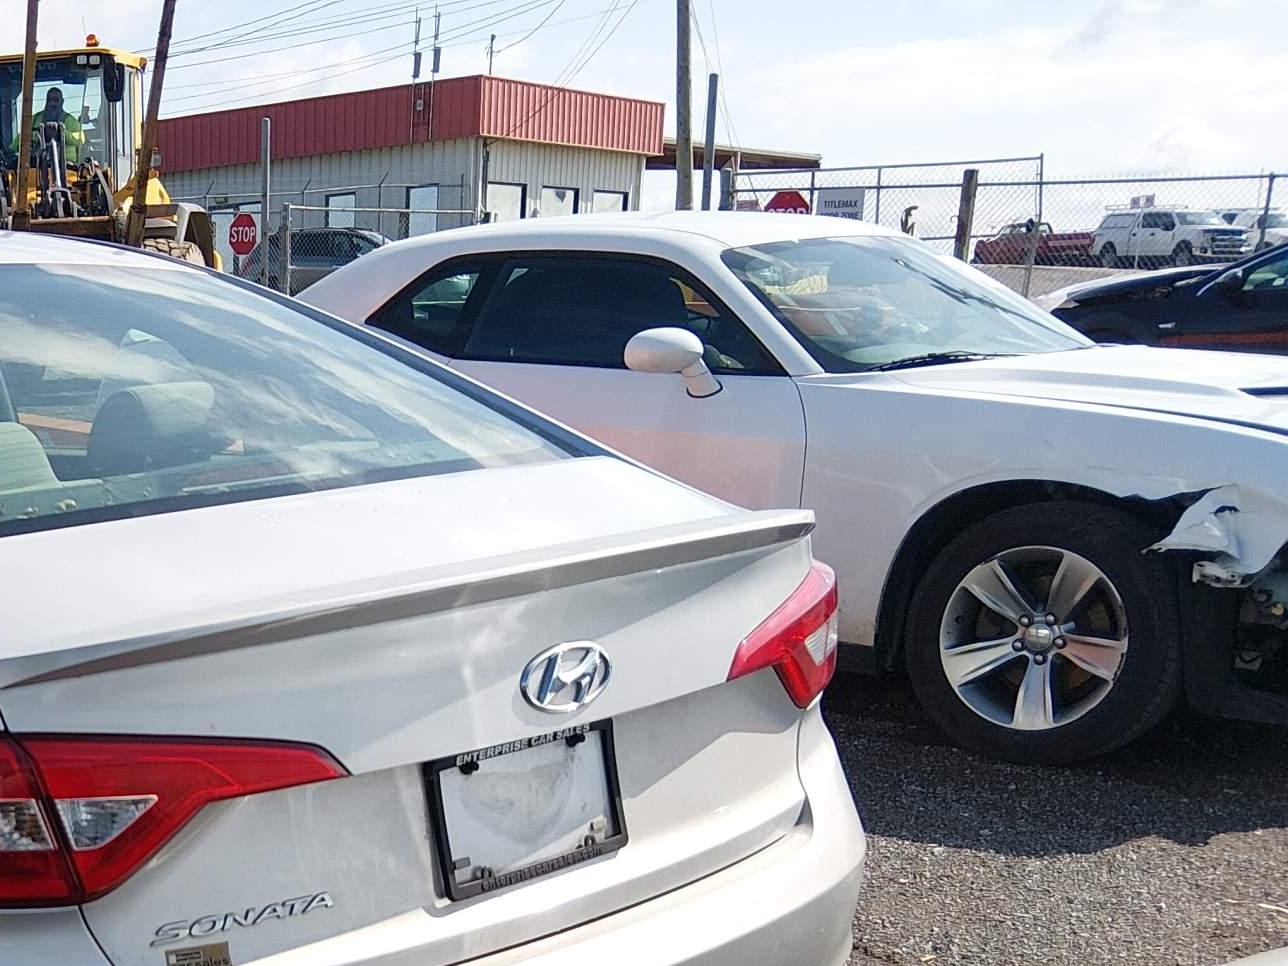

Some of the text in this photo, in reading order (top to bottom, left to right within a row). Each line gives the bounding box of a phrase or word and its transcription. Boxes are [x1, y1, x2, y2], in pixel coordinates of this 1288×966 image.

[824, 200, 859, 208] TITLEMAX
[230, 226, 256, 242] STOP
[456, 724, 590, 766] ENTERPRISE CAR SALES
[150, 891, 335, 947] SONATA
